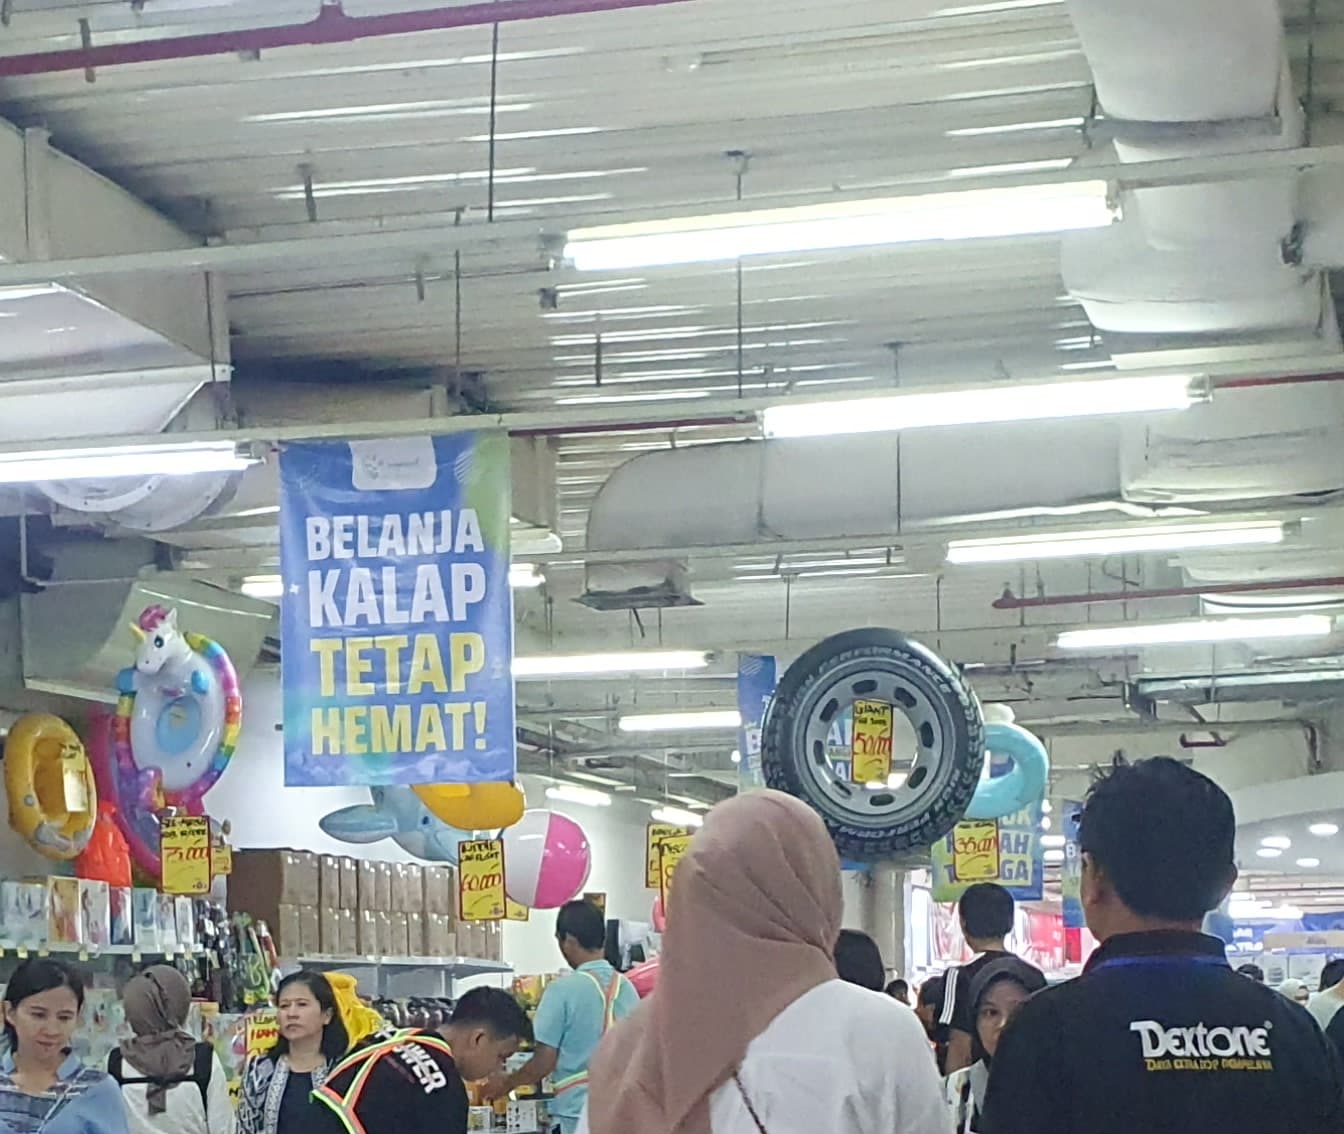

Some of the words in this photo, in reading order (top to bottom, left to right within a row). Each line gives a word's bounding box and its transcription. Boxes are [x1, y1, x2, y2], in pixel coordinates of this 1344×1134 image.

[305, 508, 485, 562] BELANJA
[307, 562, 487, 628] KALAP
[309, 632, 486, 697] TETAP
[310, 700, 487, 756] HEMAT!
